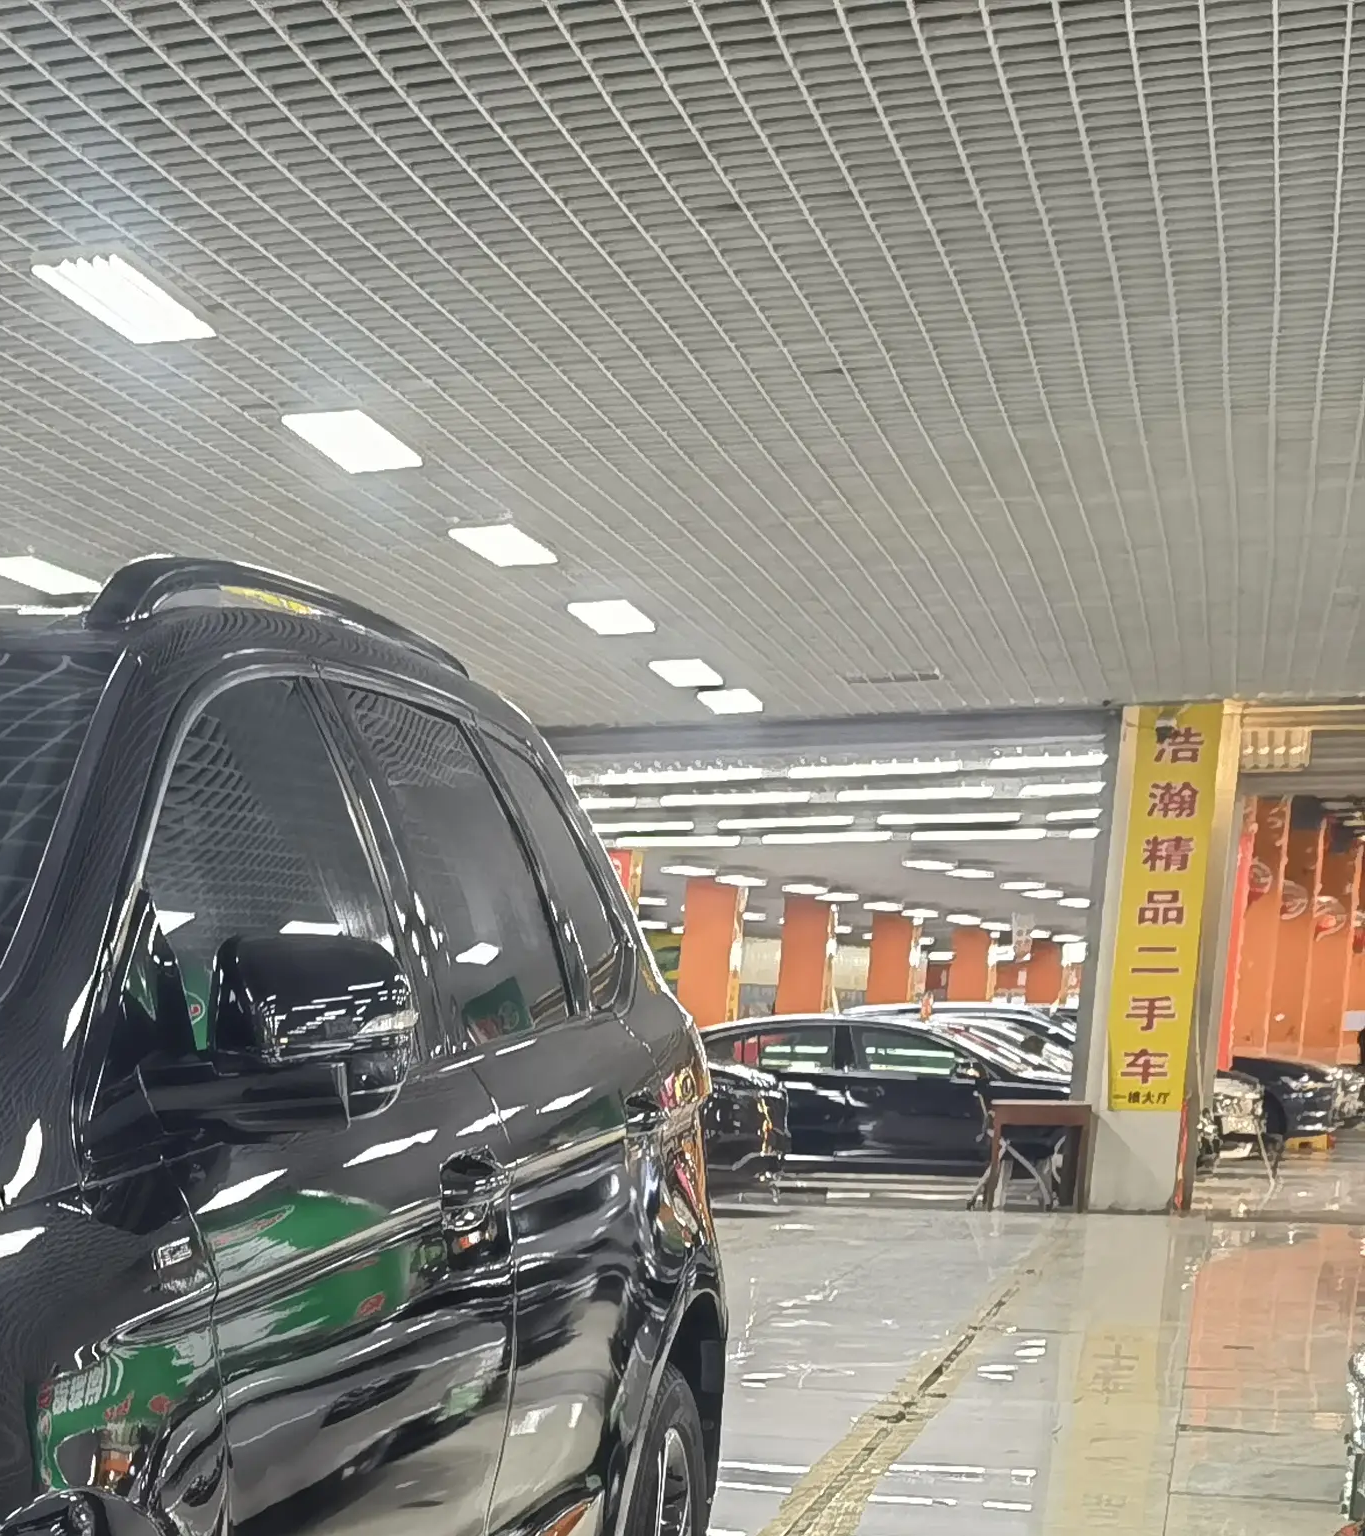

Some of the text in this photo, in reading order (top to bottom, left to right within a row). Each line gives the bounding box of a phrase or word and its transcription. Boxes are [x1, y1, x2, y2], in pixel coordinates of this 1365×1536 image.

[1120, 726, 1205, 1085] 浩瀚精品二手车
